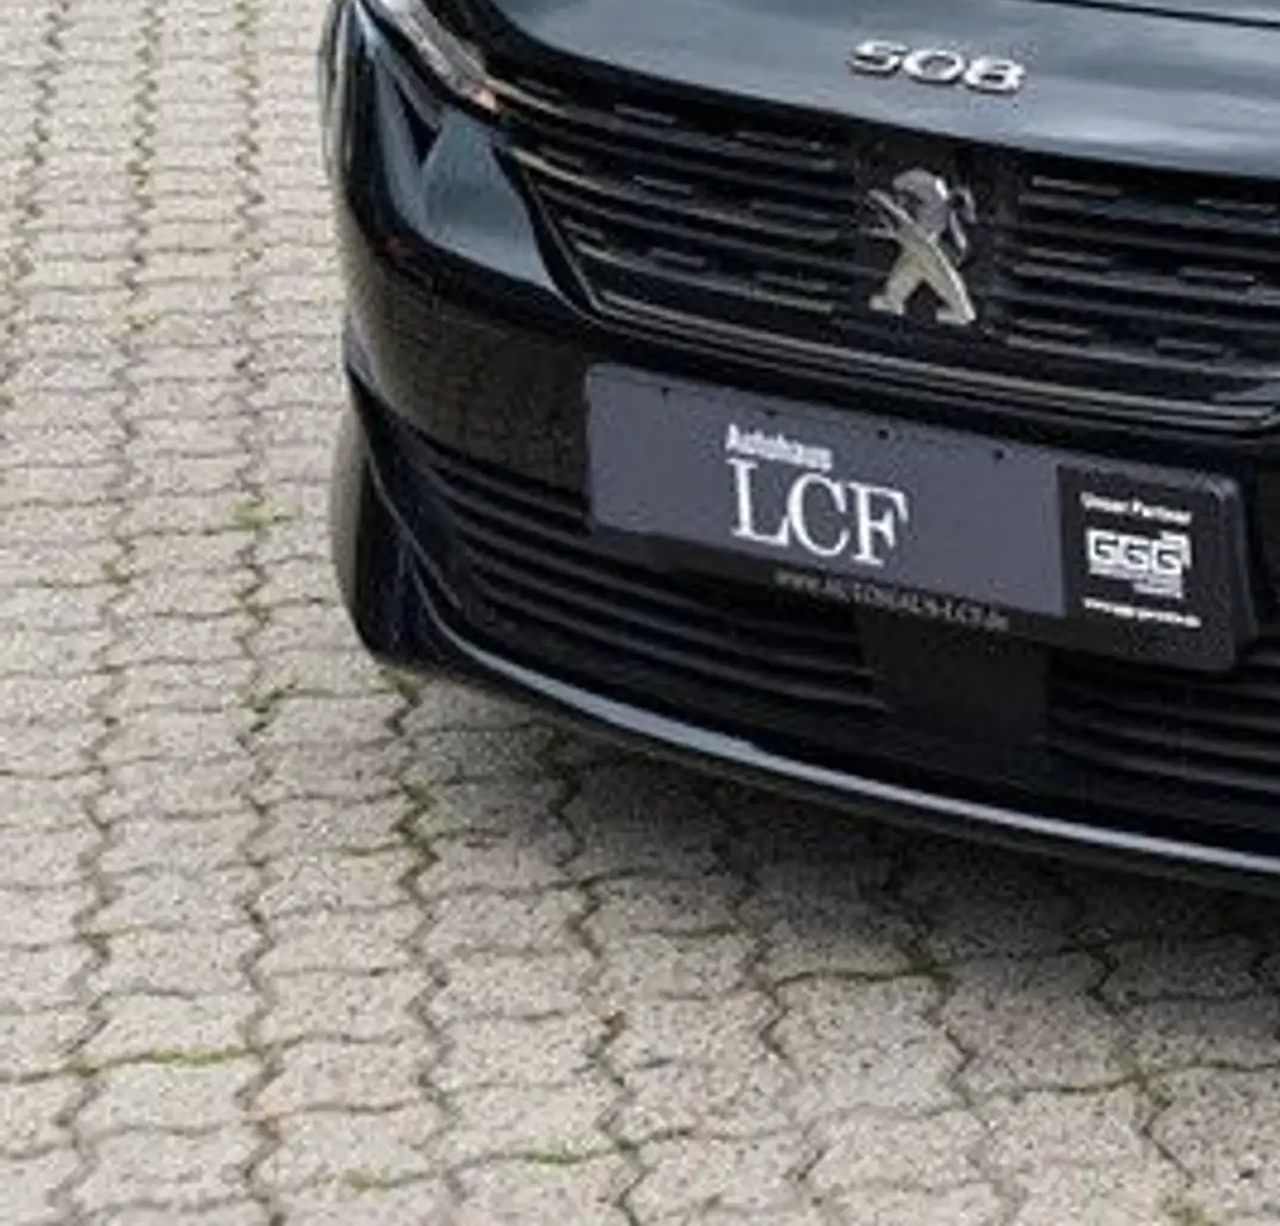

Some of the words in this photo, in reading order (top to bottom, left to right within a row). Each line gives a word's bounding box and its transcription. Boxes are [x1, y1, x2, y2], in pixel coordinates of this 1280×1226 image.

[848, 39, 1027, 93] 508
[725, 423, 832, 471] Autohaus
[725, 457, 909, 569] LCF
